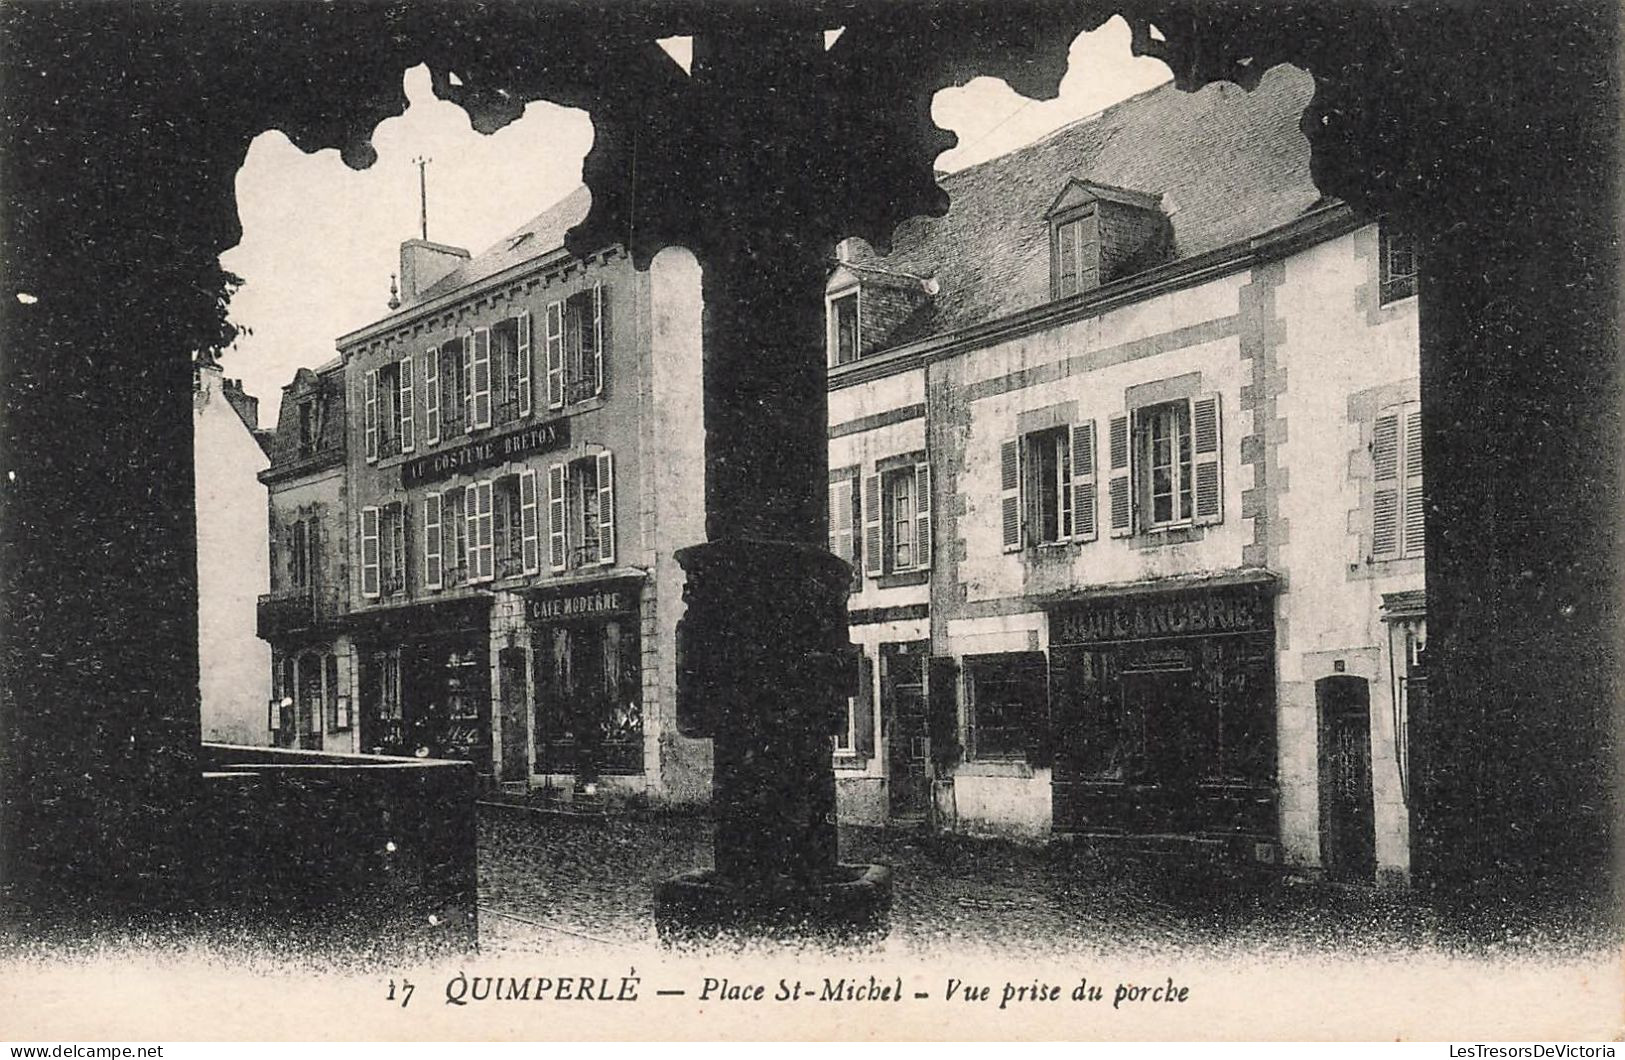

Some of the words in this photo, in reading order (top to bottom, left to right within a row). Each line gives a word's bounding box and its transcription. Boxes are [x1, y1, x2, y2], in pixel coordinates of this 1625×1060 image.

[434, 443, 495, 473] COSTUME
[504, 425, 557, 454] BRETON
[563, 592, 620, 615] MODERNE
